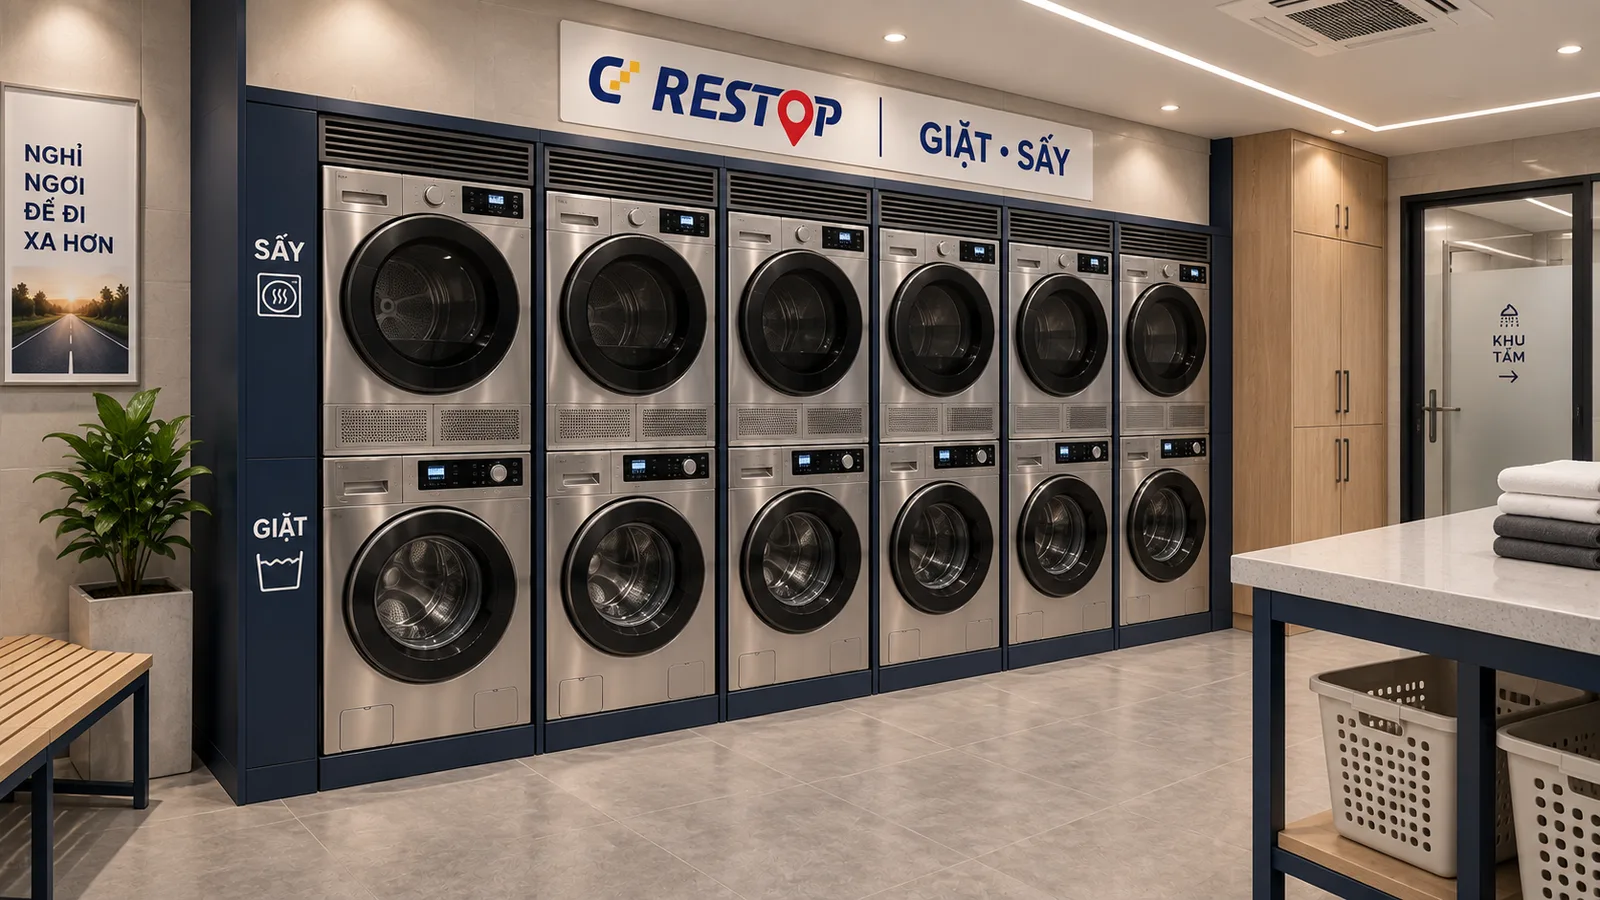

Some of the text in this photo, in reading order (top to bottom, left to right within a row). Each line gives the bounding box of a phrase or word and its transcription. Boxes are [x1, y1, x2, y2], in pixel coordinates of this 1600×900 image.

[651, 65, 843, 148] RESTOP
[24, 142, 83, 167] NGHỈ
[919, 119, 993, 169] GIẶT
[1017, 133, 1071, 177] SẤY
[24, 172, 85, 196] NGƠI
[61, 204, 86, 224] ĐI
[23, 230, 114, 255] XA HƠN
[254, 232, 306, 263] SẤY
[1492, 334, 1525, 347] KHU
[252, 511, 308, 543] GIẶT
